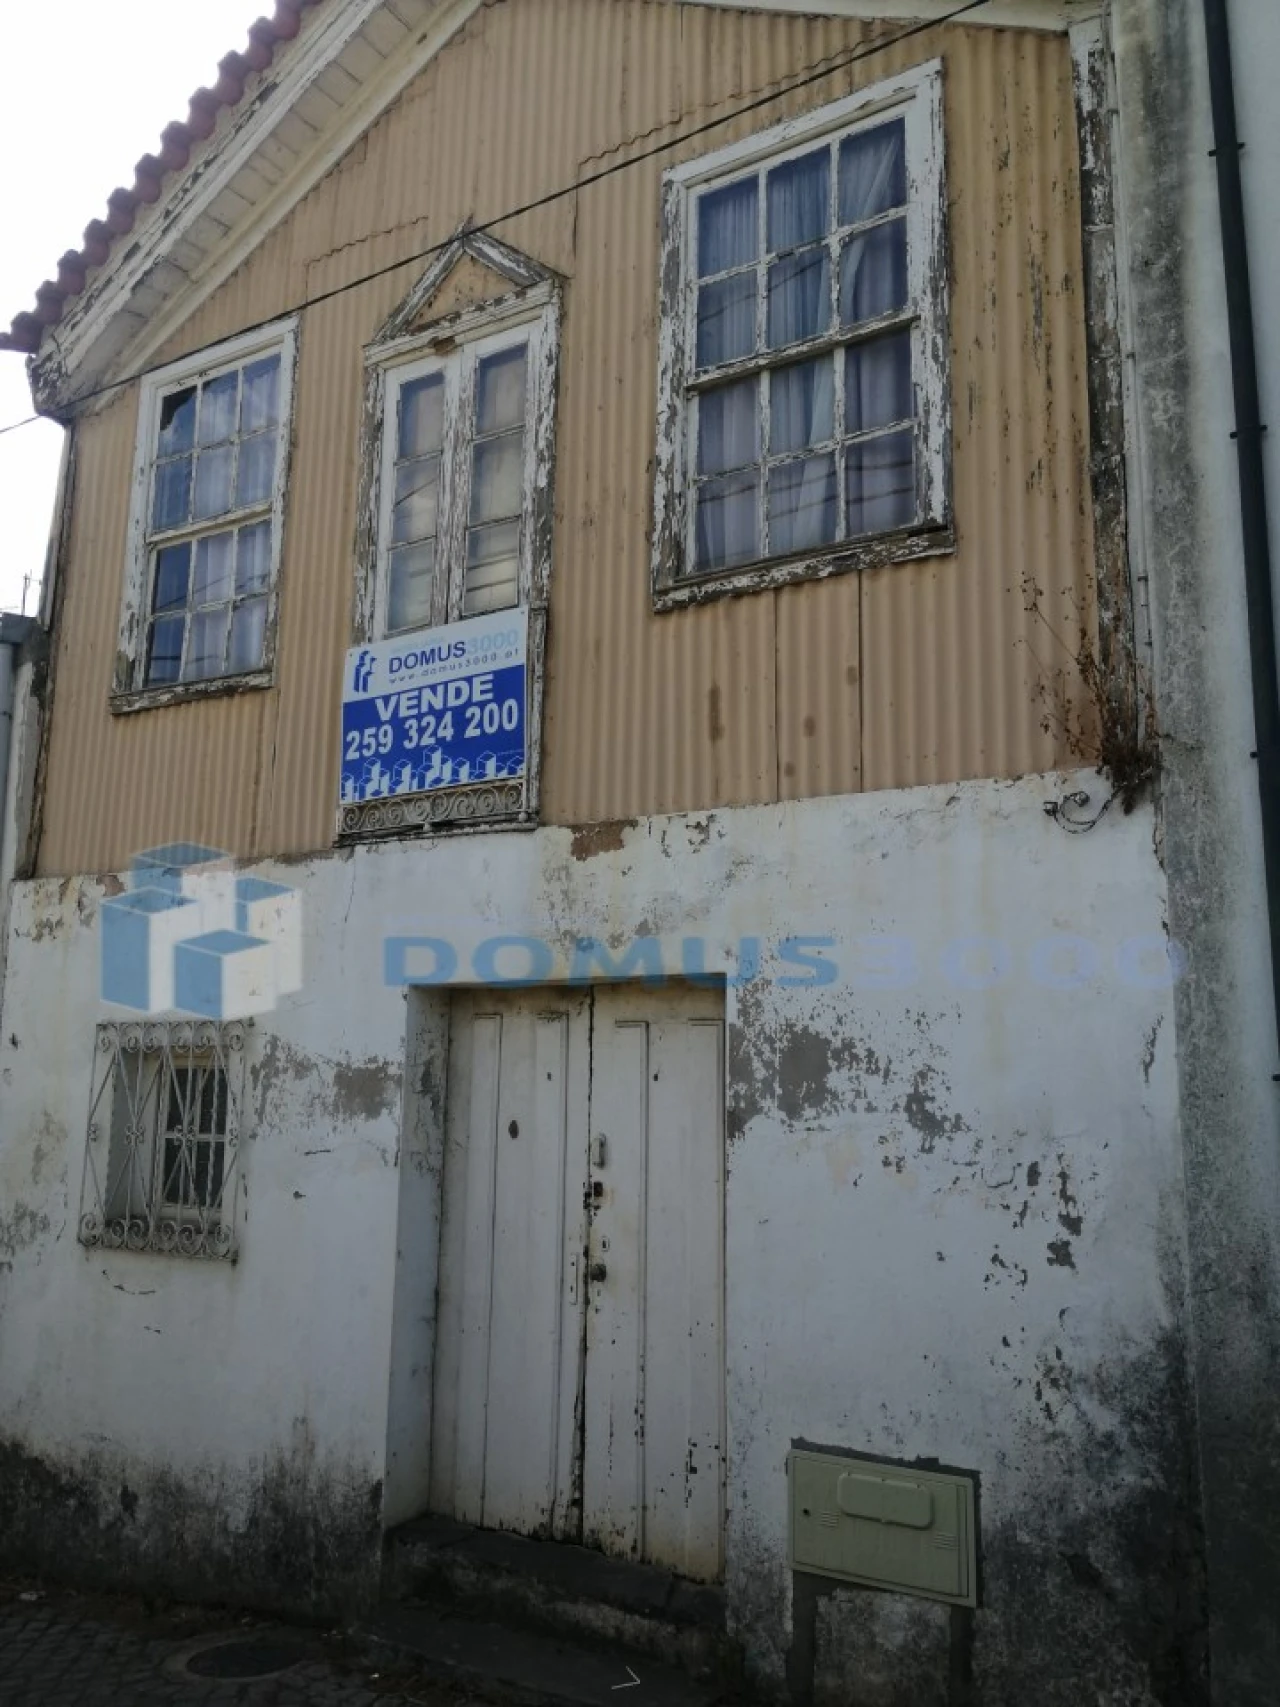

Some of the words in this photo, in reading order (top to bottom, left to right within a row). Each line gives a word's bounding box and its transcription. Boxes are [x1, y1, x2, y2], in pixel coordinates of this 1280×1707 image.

[388, 628, 519, 675] DOMUS3000
[375, 673, 495, 721] VENDE
[345, 724, 394, 760] 259
[403, 711, 455, 749] 324
[464, 698, 519, 738] 200
